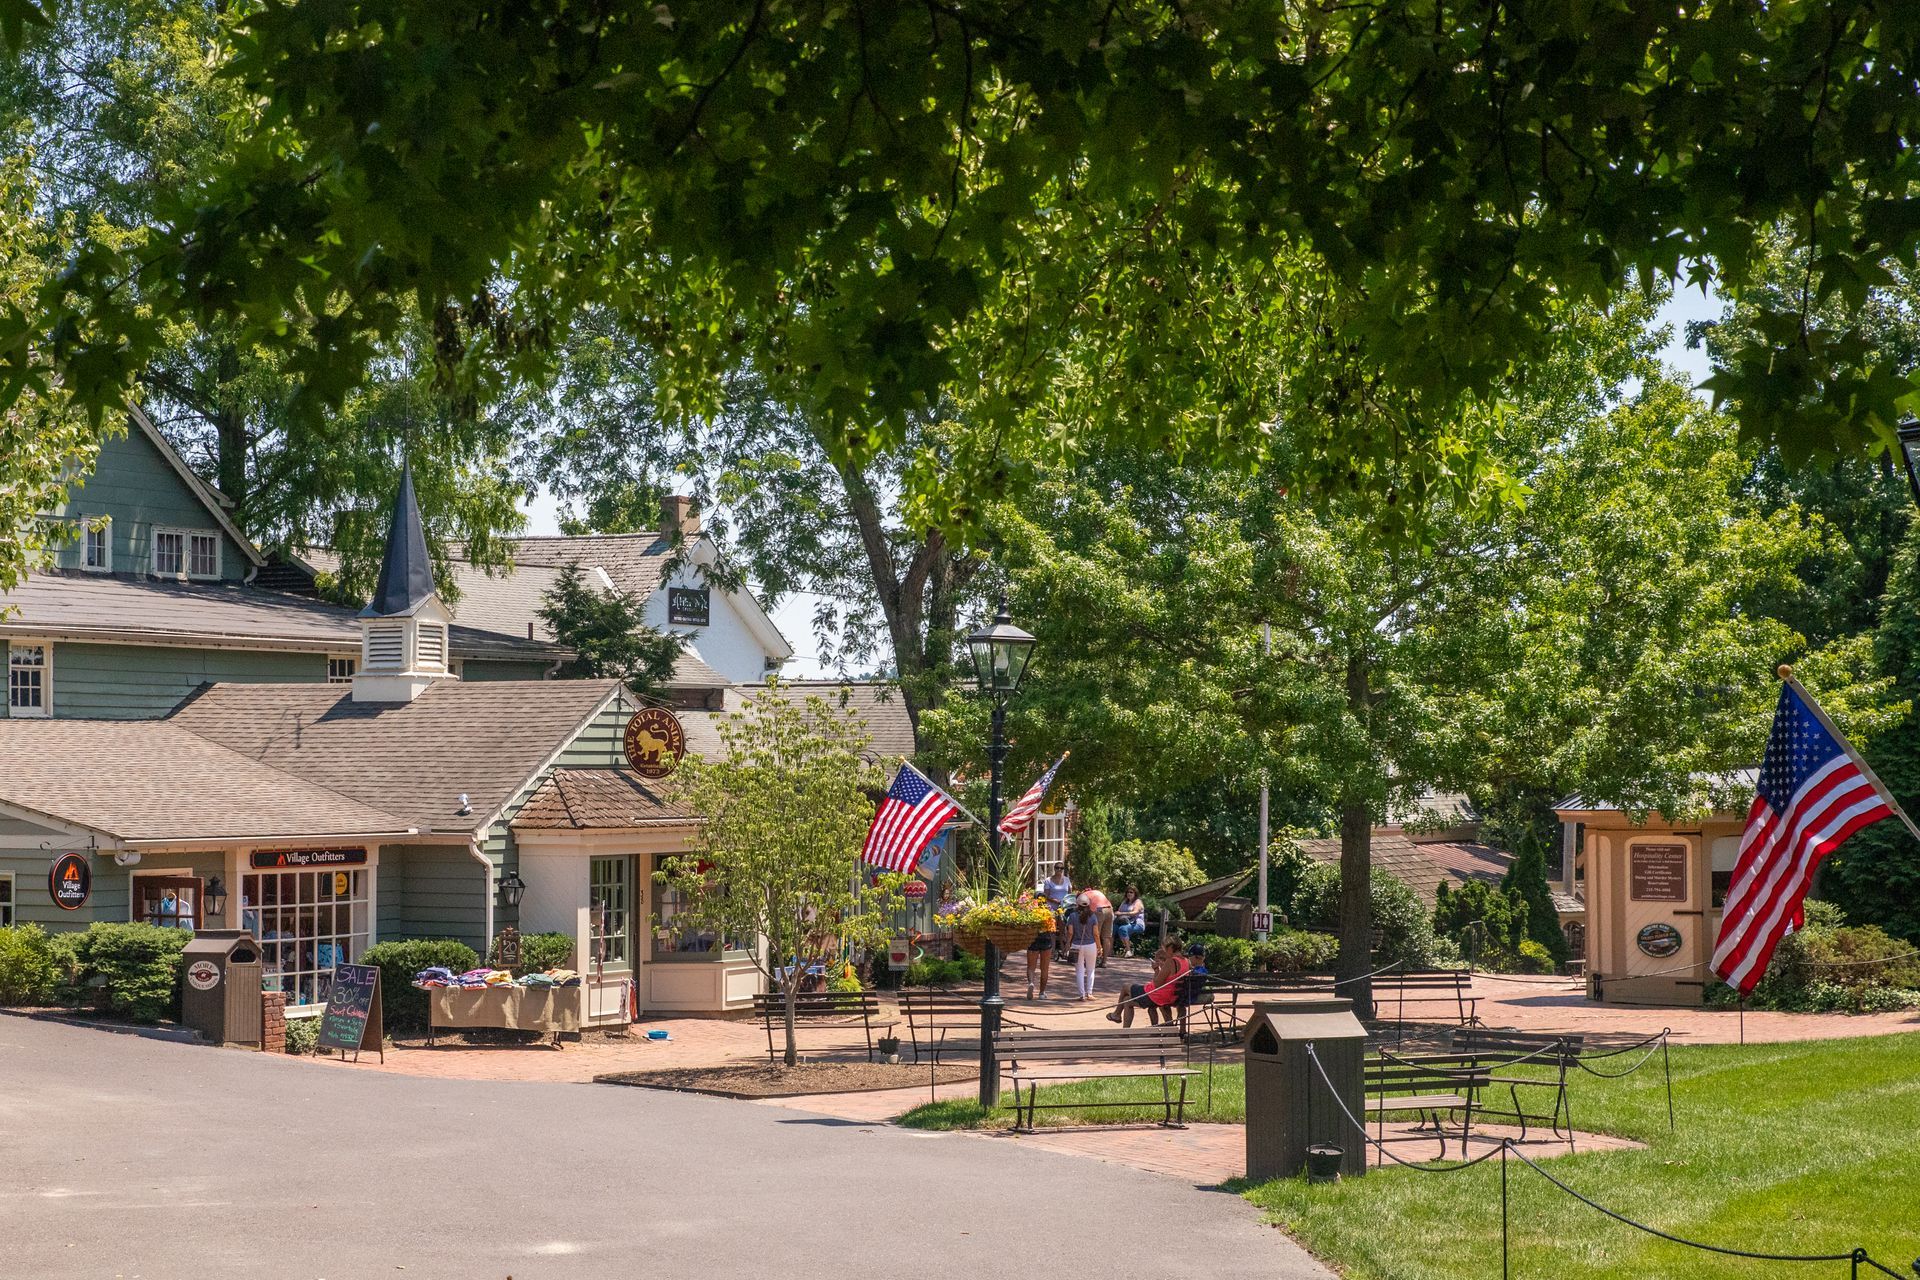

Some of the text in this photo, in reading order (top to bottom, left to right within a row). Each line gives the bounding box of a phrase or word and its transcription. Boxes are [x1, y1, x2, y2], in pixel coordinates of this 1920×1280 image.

[627, 711, 681, 760] THE TOTAL ANIMA
[287, 851, 345, 865] Village Outfitters
[1633, 852, 1664, 860] Hospitality
[63, 881, 80, 891] Village
[58, 890, 84, 898] Outfitters
[194, 962, 213, 970] MORE
[336, 967, 376, 985] SALE
[334, 986, 361, 1004] 30%
